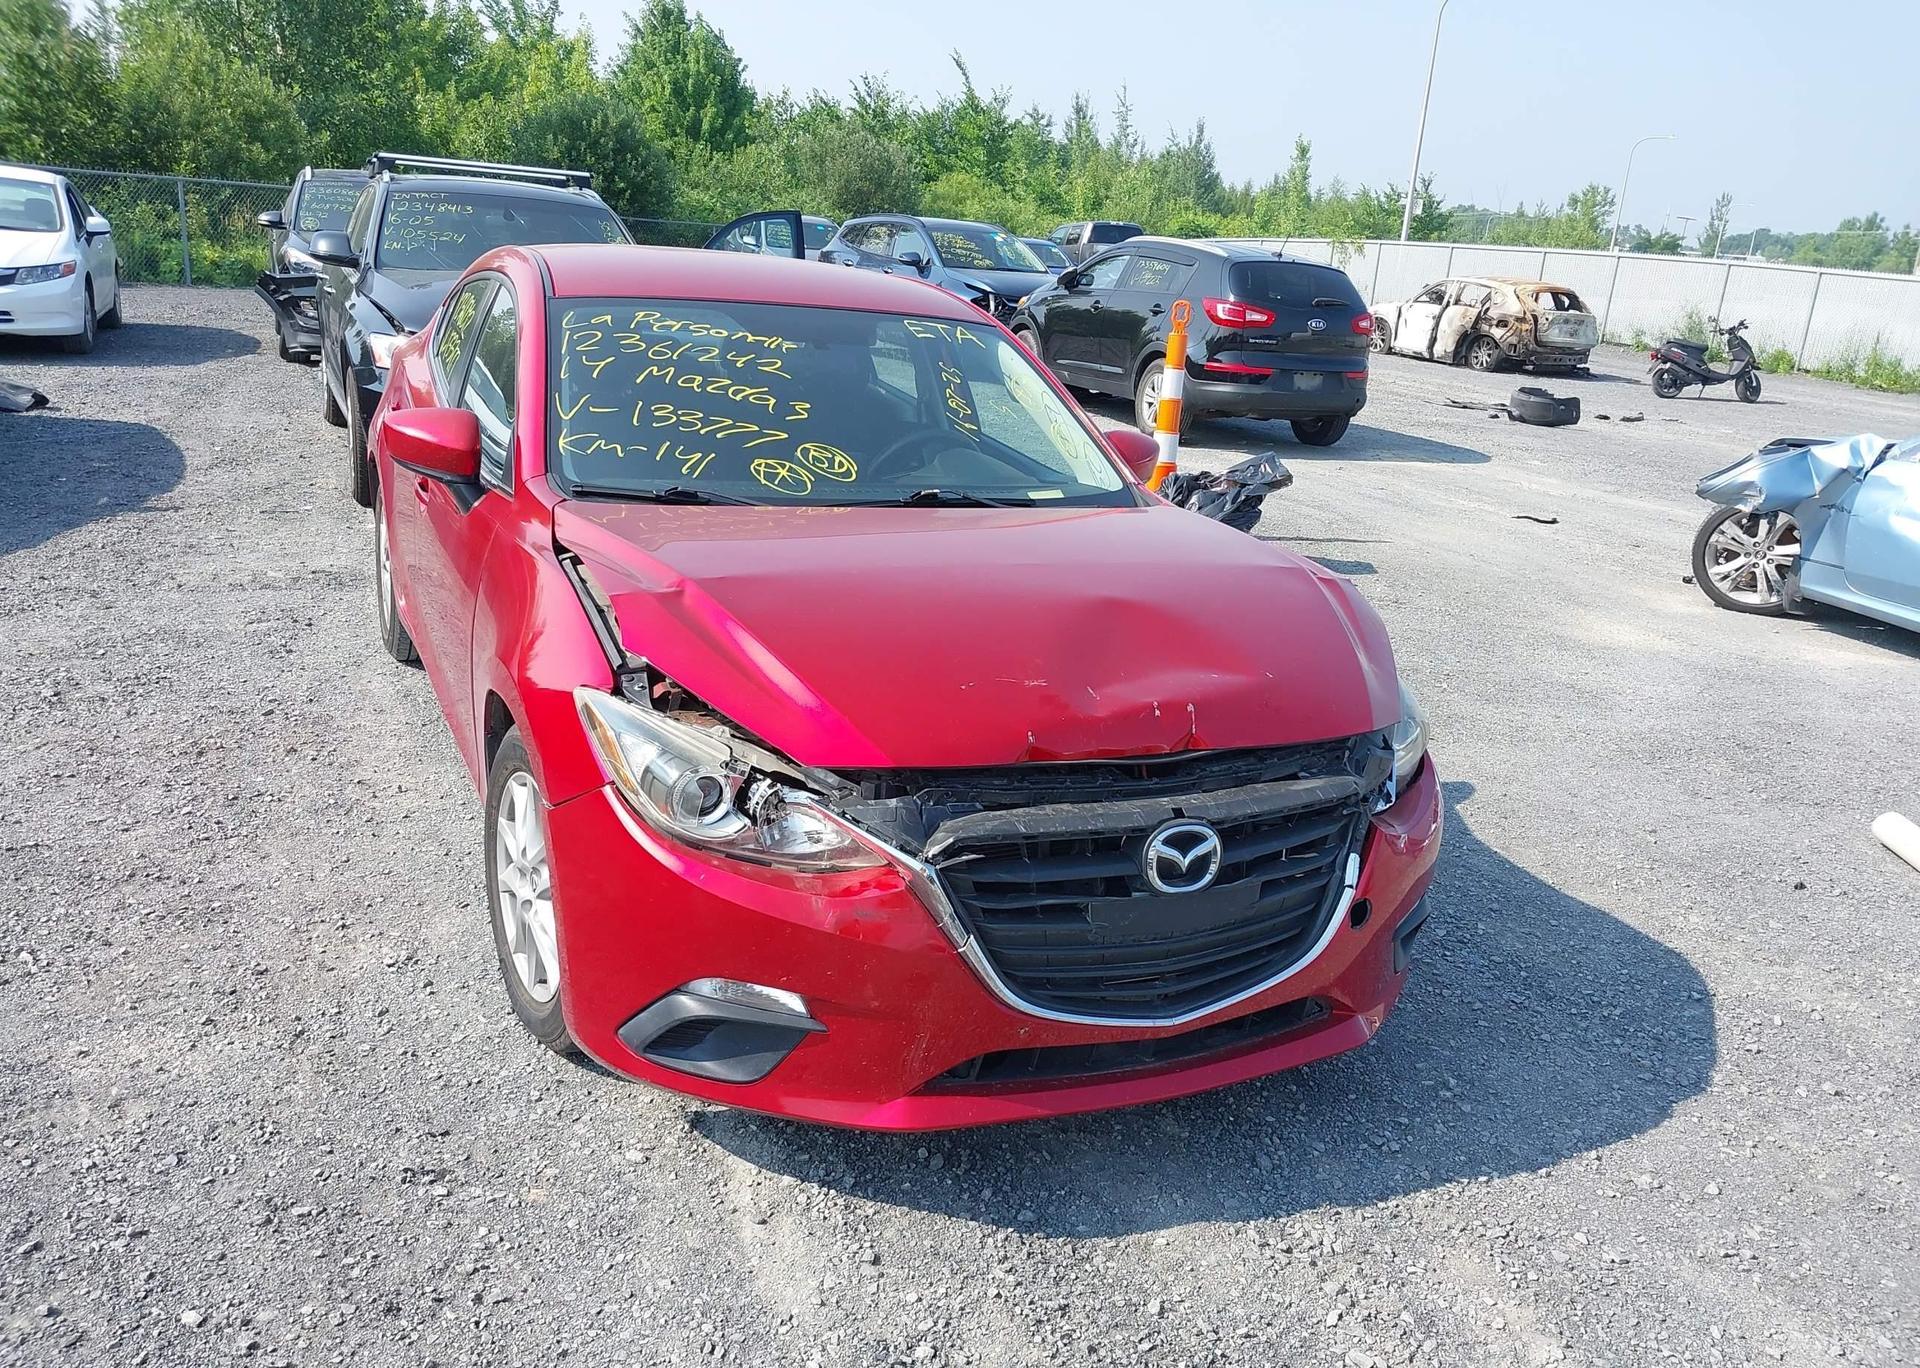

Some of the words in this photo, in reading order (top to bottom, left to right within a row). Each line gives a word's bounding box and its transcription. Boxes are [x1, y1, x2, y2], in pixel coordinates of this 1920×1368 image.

[392, 192, 449, 200] INTACT
[390, 200, 474, 214] 12348413
[387, 211, 436, 226] 16-05
[384, 225, 467, 245] V-105524
[561, 310, 614, 329] La
[903, 319, 987, 349] ETA
[560, 329, 793, 380] 12361242
[559, 354, 617, 379] 14
